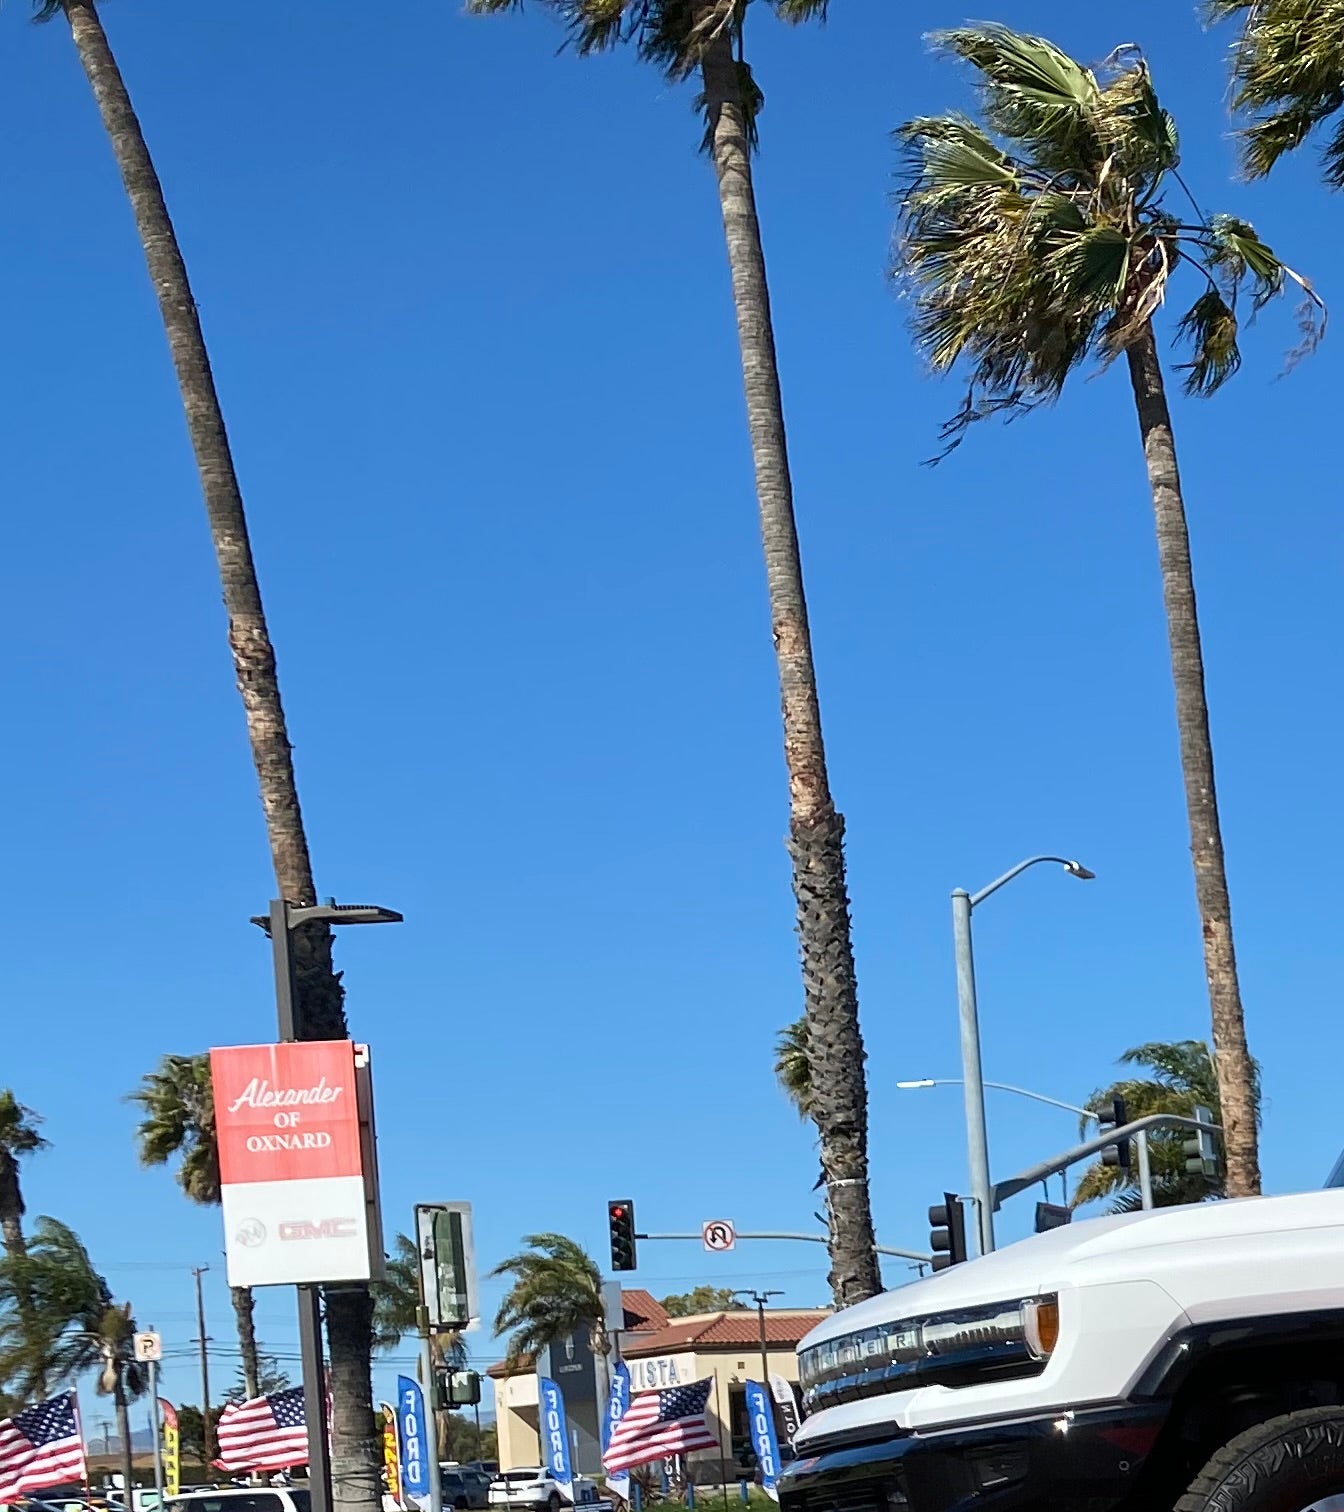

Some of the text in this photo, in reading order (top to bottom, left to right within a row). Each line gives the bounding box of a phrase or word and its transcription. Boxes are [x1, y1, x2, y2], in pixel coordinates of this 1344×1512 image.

[227, 1076, 343, 1112] Alexander
[273, 1112, 300, 1128] OF
[246, 1132, 331, 1152] OXNARD
[278, 1217, 357, 1241] GMC
